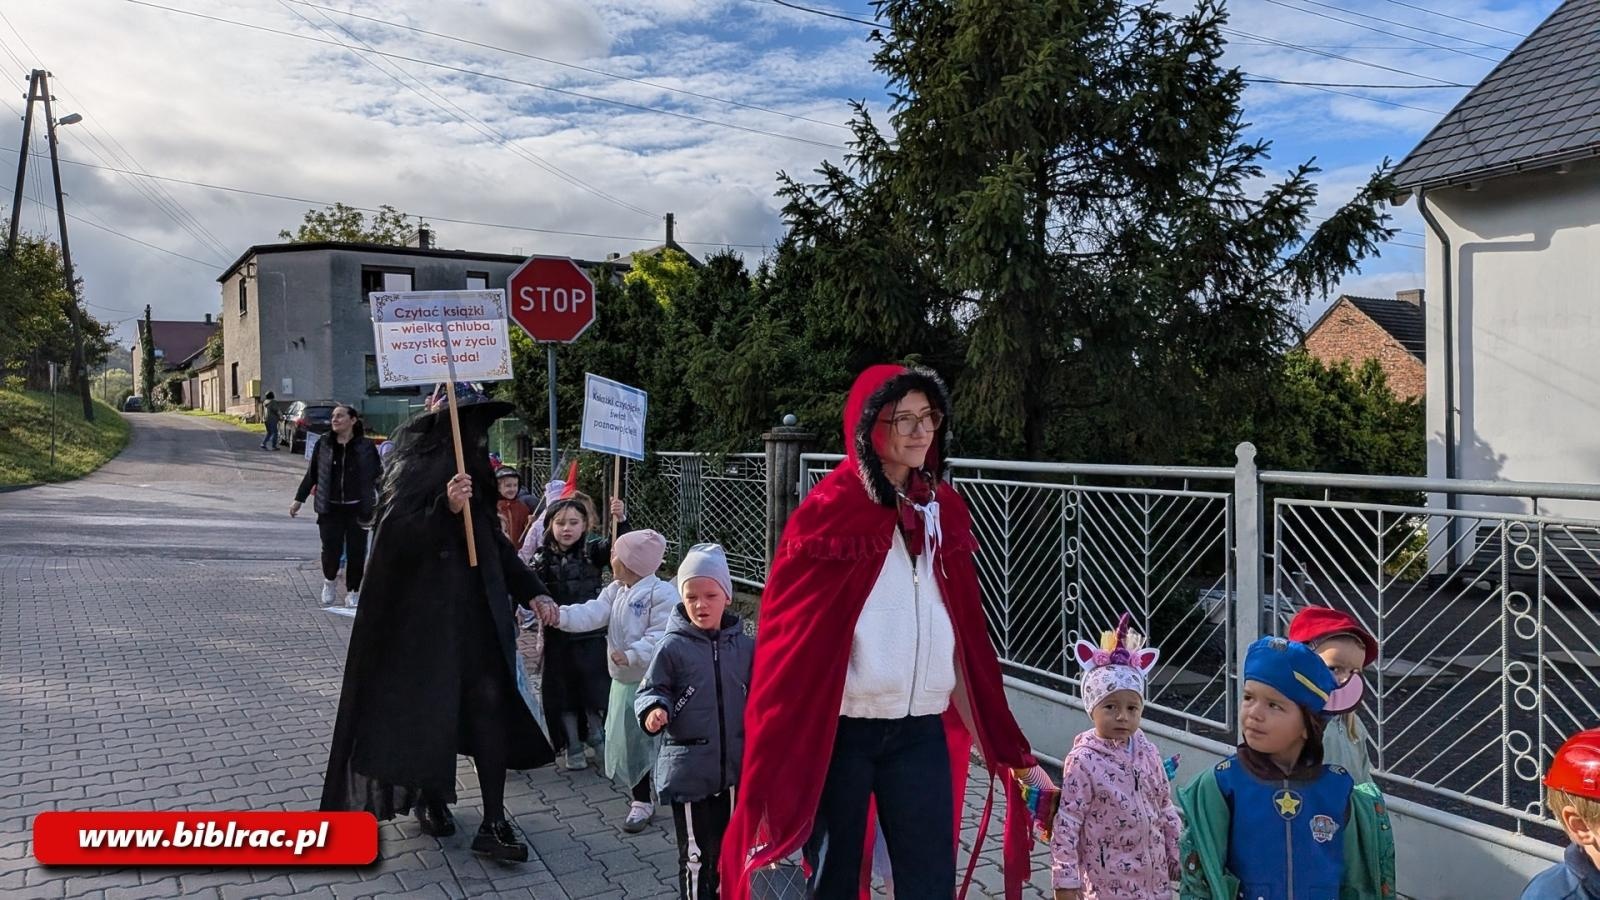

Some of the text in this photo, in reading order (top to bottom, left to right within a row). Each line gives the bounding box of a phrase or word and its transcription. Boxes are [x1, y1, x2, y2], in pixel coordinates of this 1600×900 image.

[520, 286, 586, 313] STOP
[394, 305, 484, 320] Czytać książki
[401, 323, 444, 334] wielka
[447, 321, 494, 332] chluba,
[391, 336, 497, 352] wszystko w życiu
[414, 351, 480, 365] Ci się uda!
